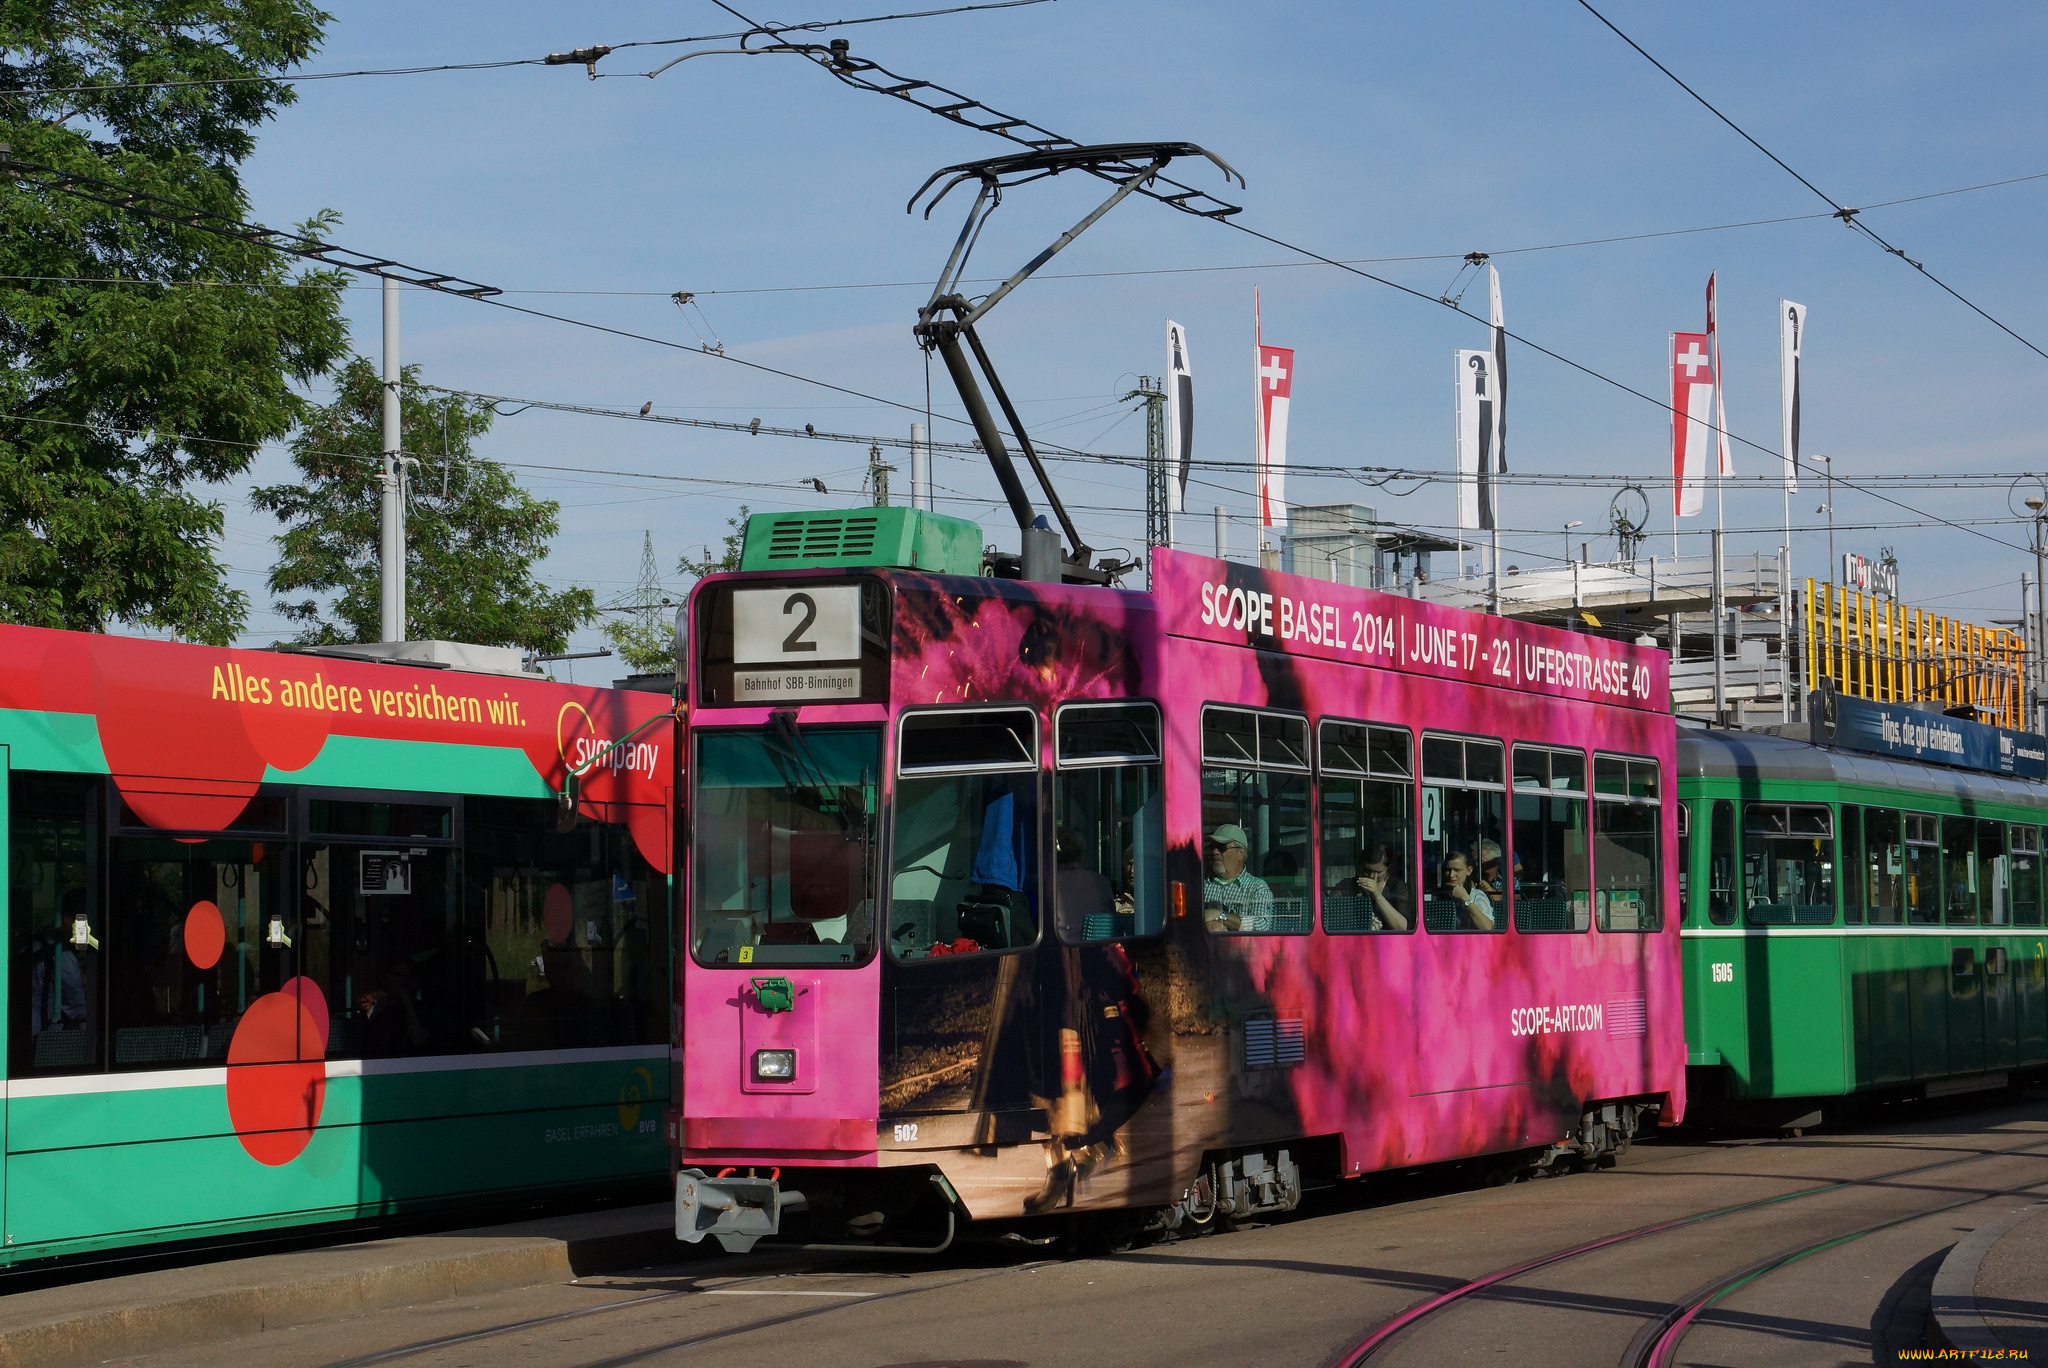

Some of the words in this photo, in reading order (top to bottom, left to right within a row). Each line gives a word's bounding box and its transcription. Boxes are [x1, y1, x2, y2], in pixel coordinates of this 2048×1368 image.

[782, 592, 817, 653] 2
[1201, 581, 1273, 636] SCOPE
[1281, 597, 1347, 649] BASEL
[1352, 611, 1395, 657] 2014
[1411, 623, 1457, 668] JUNE
[1461, 632, 1478, 671] 17
[1492, 638, 1511, 678] 22
[1525, 644, 1628, 696] UFERSTRASSE
[1632, 665, 1650, 700] 40
[212, 662, 273, 705] Alles
[280, 672, 363, 714] andere
[368, 684, 482, 723] versichern
[486, 692, 526, 727] wir.
[745, 677, 781, 691] Bahnhof
[786, 675, 853, 690] SBB-Binningen
[1881, 712, 1901, 749] Trips,
[1902, 716, 1914, 746] die
[1916, 720, 1928, 754] gut
[1930, 721, 1965, 755] einfahren.
[575, 737, 659, 780] sympany
[1427, 793, 1435, 836] 2
[743, 950, 748, 960] 3
[1711, 963, 1733, 982] 1505
[1511, 1003, 1603, 1036] SCOPE-ART.COM
[546, 1128, 572, 1143] BASEL
[574, 1122, 619, 1140] ERFAHREN
[639, 1120, 656, 1133] BVB
[894, 1124, 918, 1142] 502
